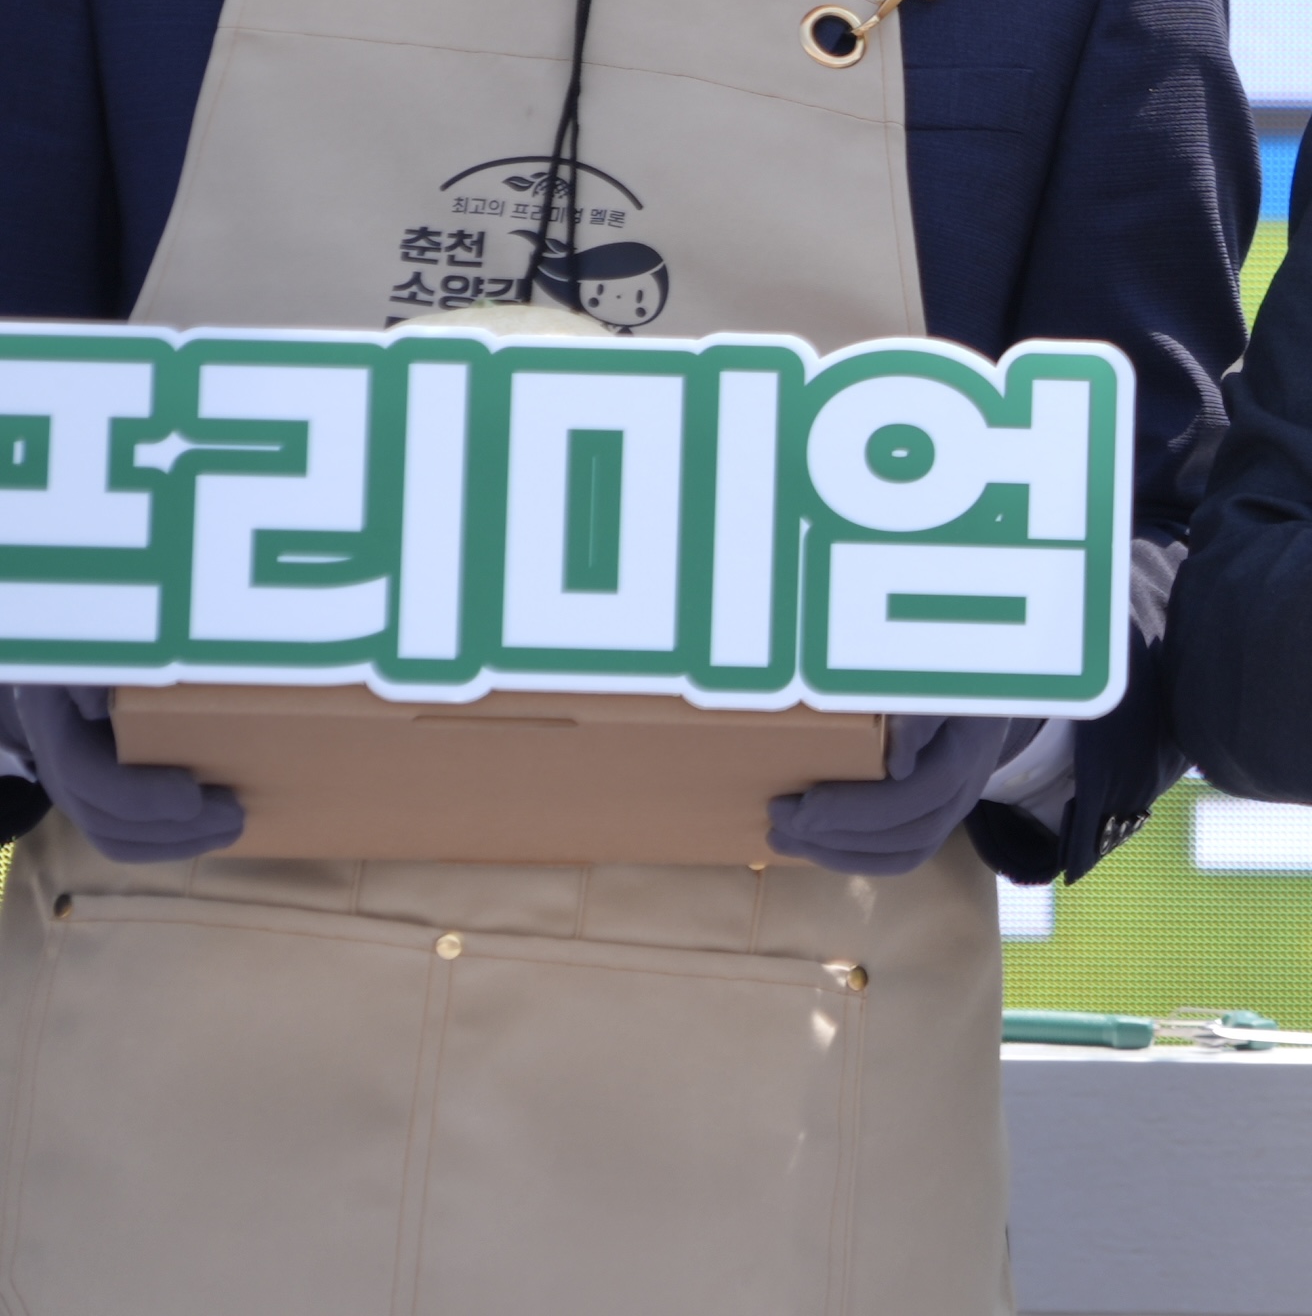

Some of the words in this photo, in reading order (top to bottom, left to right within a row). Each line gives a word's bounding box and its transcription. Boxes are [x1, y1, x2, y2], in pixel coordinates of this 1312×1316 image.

[451, 197, 504, 217] 최고의
[589, 209, 626, 229] 멜론
[399, 226, 485, 268] 춘천
